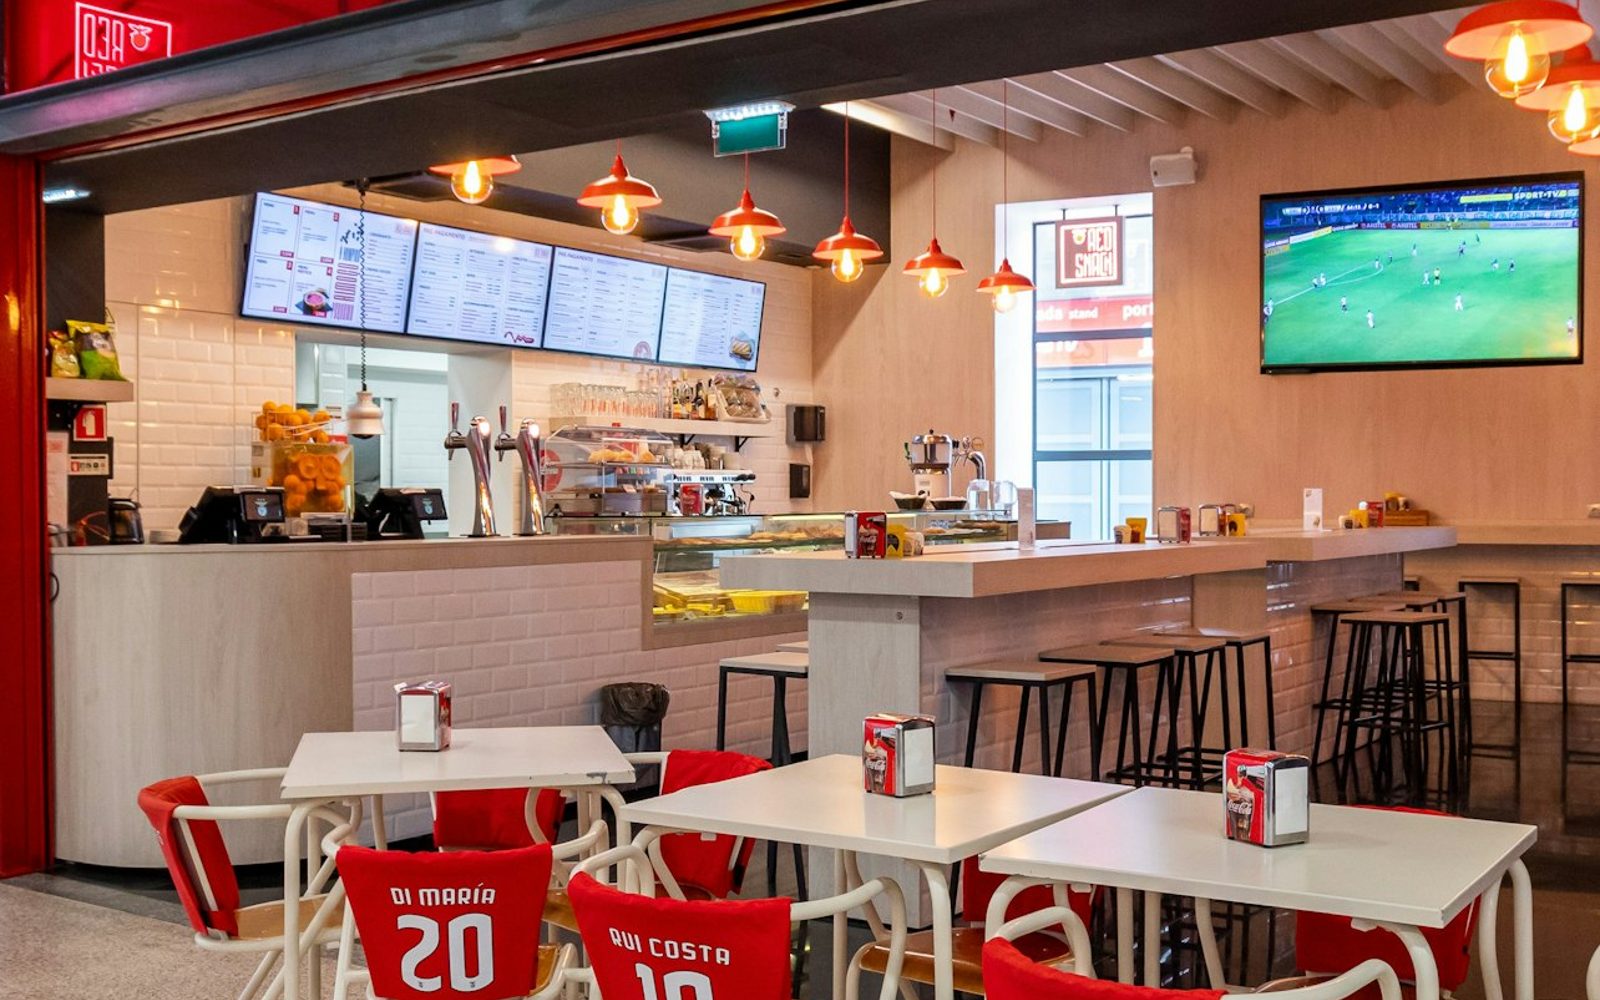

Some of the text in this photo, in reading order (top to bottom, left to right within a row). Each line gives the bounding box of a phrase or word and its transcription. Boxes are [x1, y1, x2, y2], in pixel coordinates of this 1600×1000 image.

[1087, 226, 1112, 252] RED
[1068, 307, 1098, 319] stand
[390, 882, 496, 906] DI MARÍA
[397, 912, 494, 993] 20
[608, 927, 730, 966] RUI COSTA
